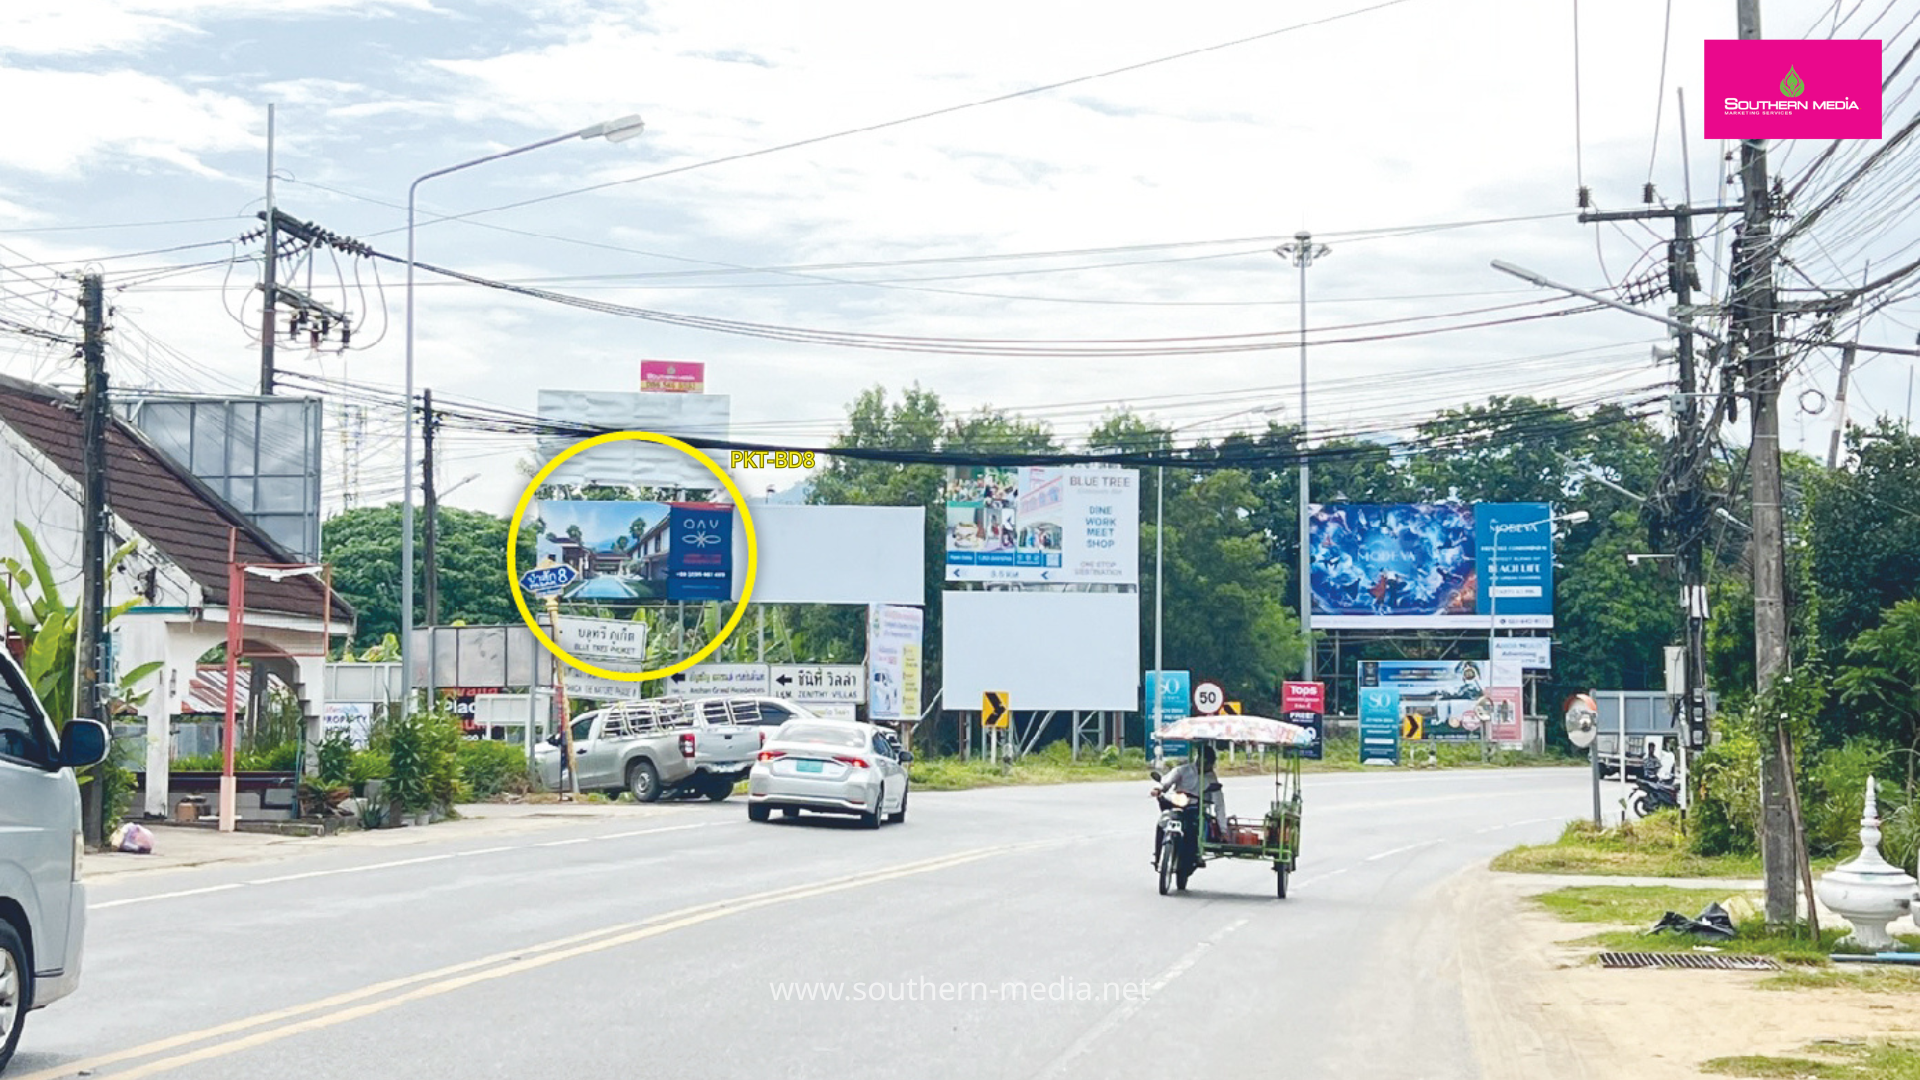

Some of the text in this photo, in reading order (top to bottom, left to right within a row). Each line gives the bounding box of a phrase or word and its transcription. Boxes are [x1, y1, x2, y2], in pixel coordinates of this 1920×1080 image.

[1070, 476, 1131, 488] BLUE TREE
[1089, 505, 1113, 515] DINE
[1085, 518, 1117, 527] WORK
[1086, 528, 1115, 537] MEET
[1086, 539, 1115, 549] SHOP
[557, 567, 569, 583] 8
[1290, 685, 1318, 696] Tops
[1199, 691, 1216, 704] 50
[444, 699, 476, 714] Plac
